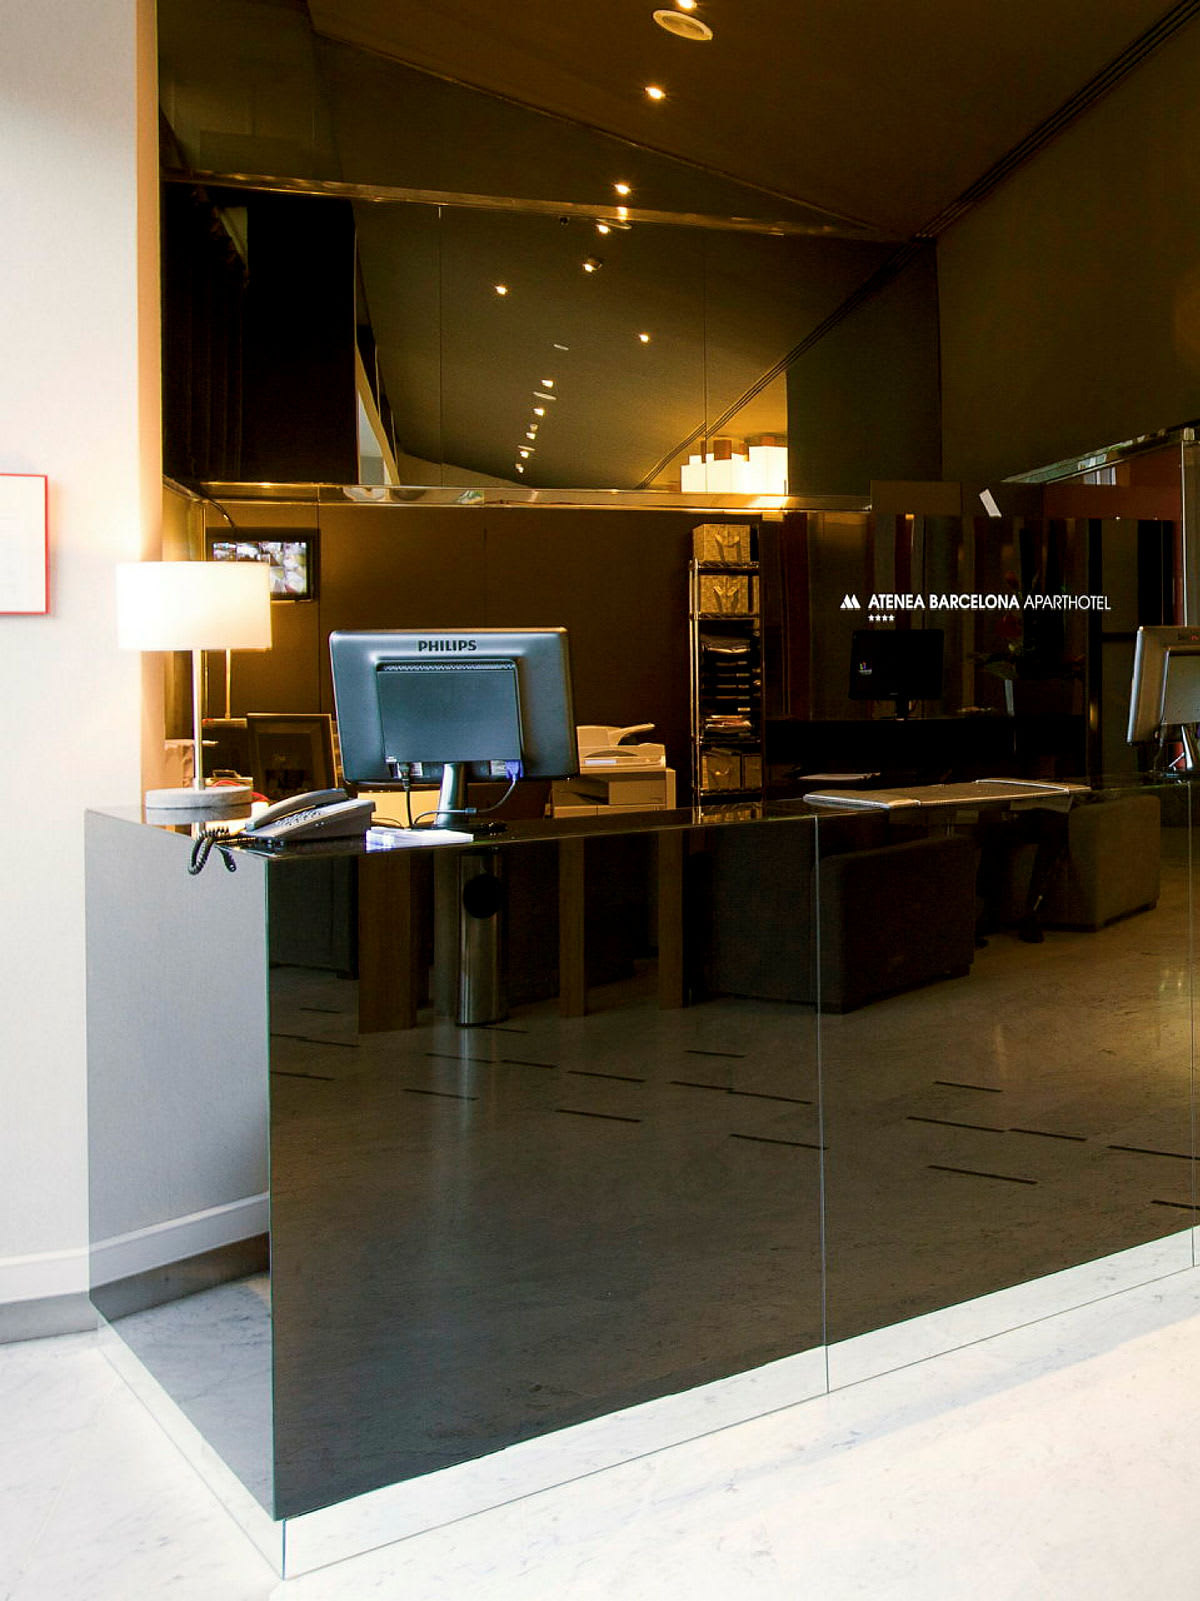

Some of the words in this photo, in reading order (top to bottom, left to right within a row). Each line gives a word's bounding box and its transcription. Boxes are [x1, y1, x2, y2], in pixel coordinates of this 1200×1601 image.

[868, 594, 925, 609] ATENEA
[929, 594, 1020, 609] BARCELONA
[1023, 595, 1111, 610] APARTHOTEL
[418, 640, 477, 651] PHILIPS
